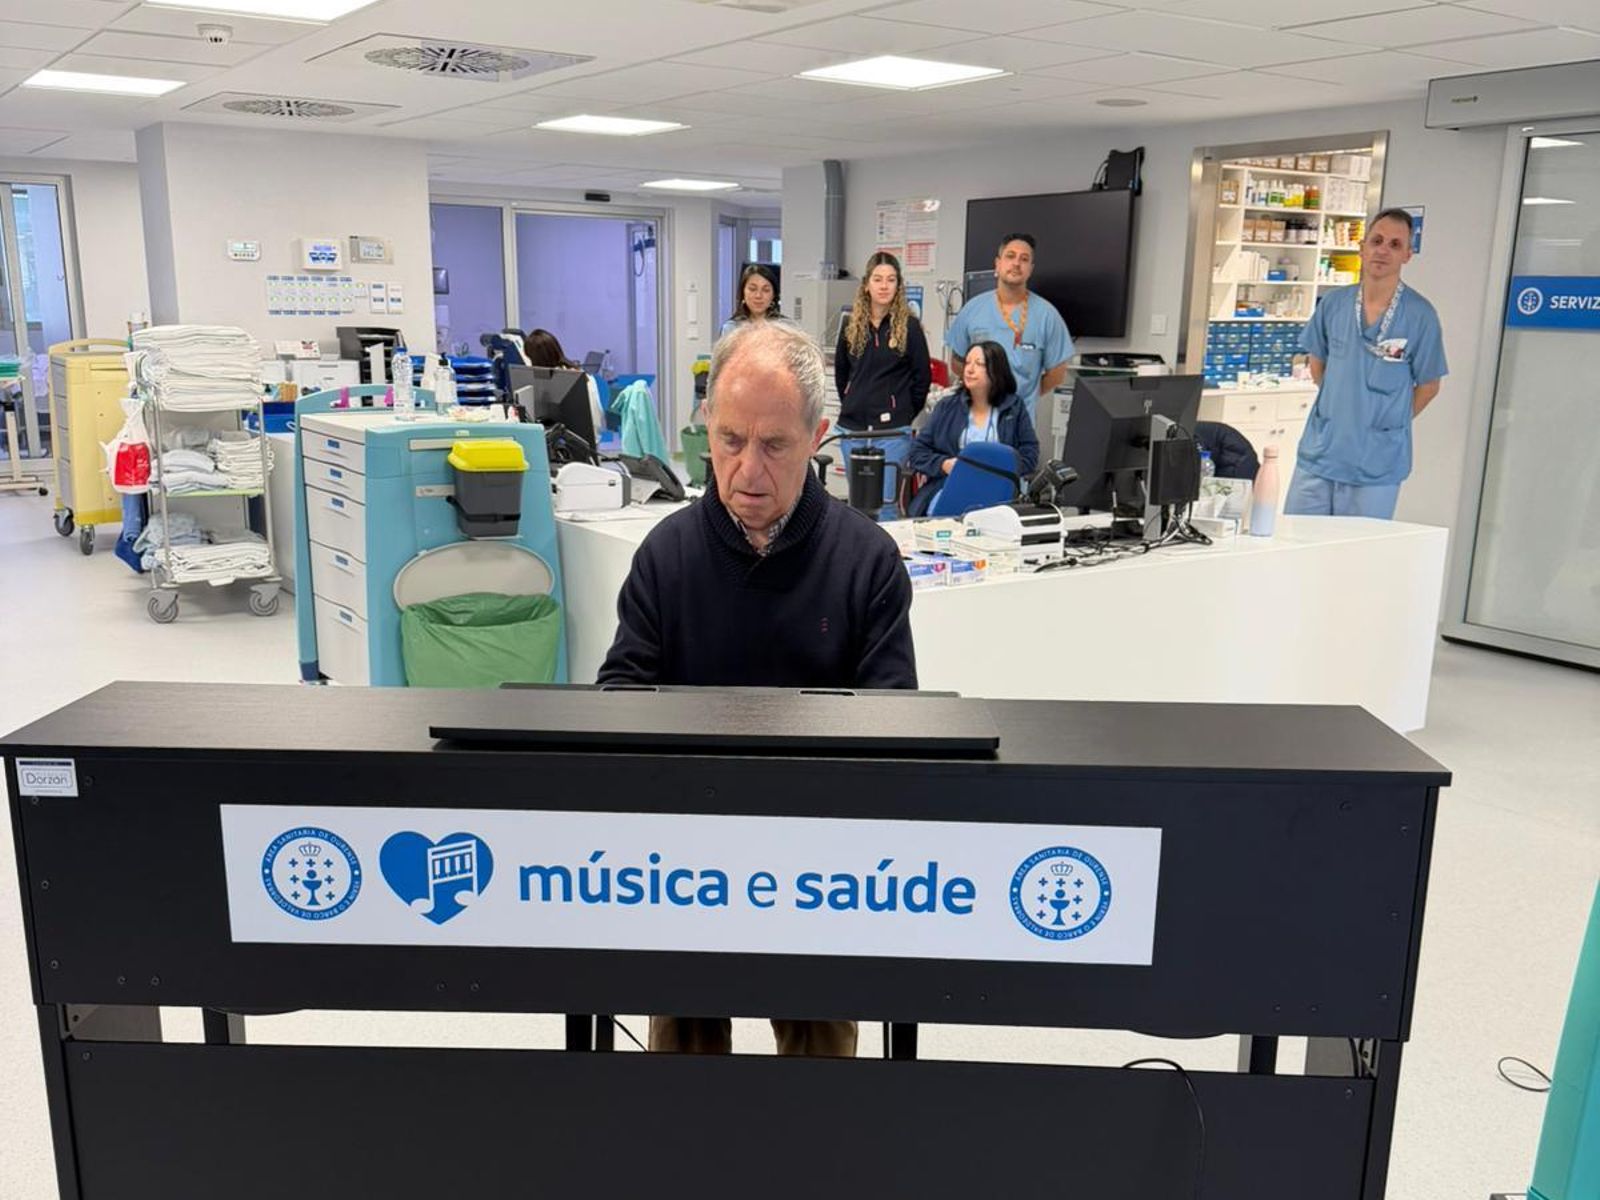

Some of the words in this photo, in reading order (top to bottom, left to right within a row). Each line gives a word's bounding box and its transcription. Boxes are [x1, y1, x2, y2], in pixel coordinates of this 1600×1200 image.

[276, 829, 316, 845] SANITARIA
[330, 835, 357, 865] OURENSE
[519, 851, 728, 905] música
[747, 871, 778, 907] e
[795, 858, 977, 914] saúde
[1028, 849, 1069, 864] SANITARIA
[1084, 855, 1108, 885] OURENSE
